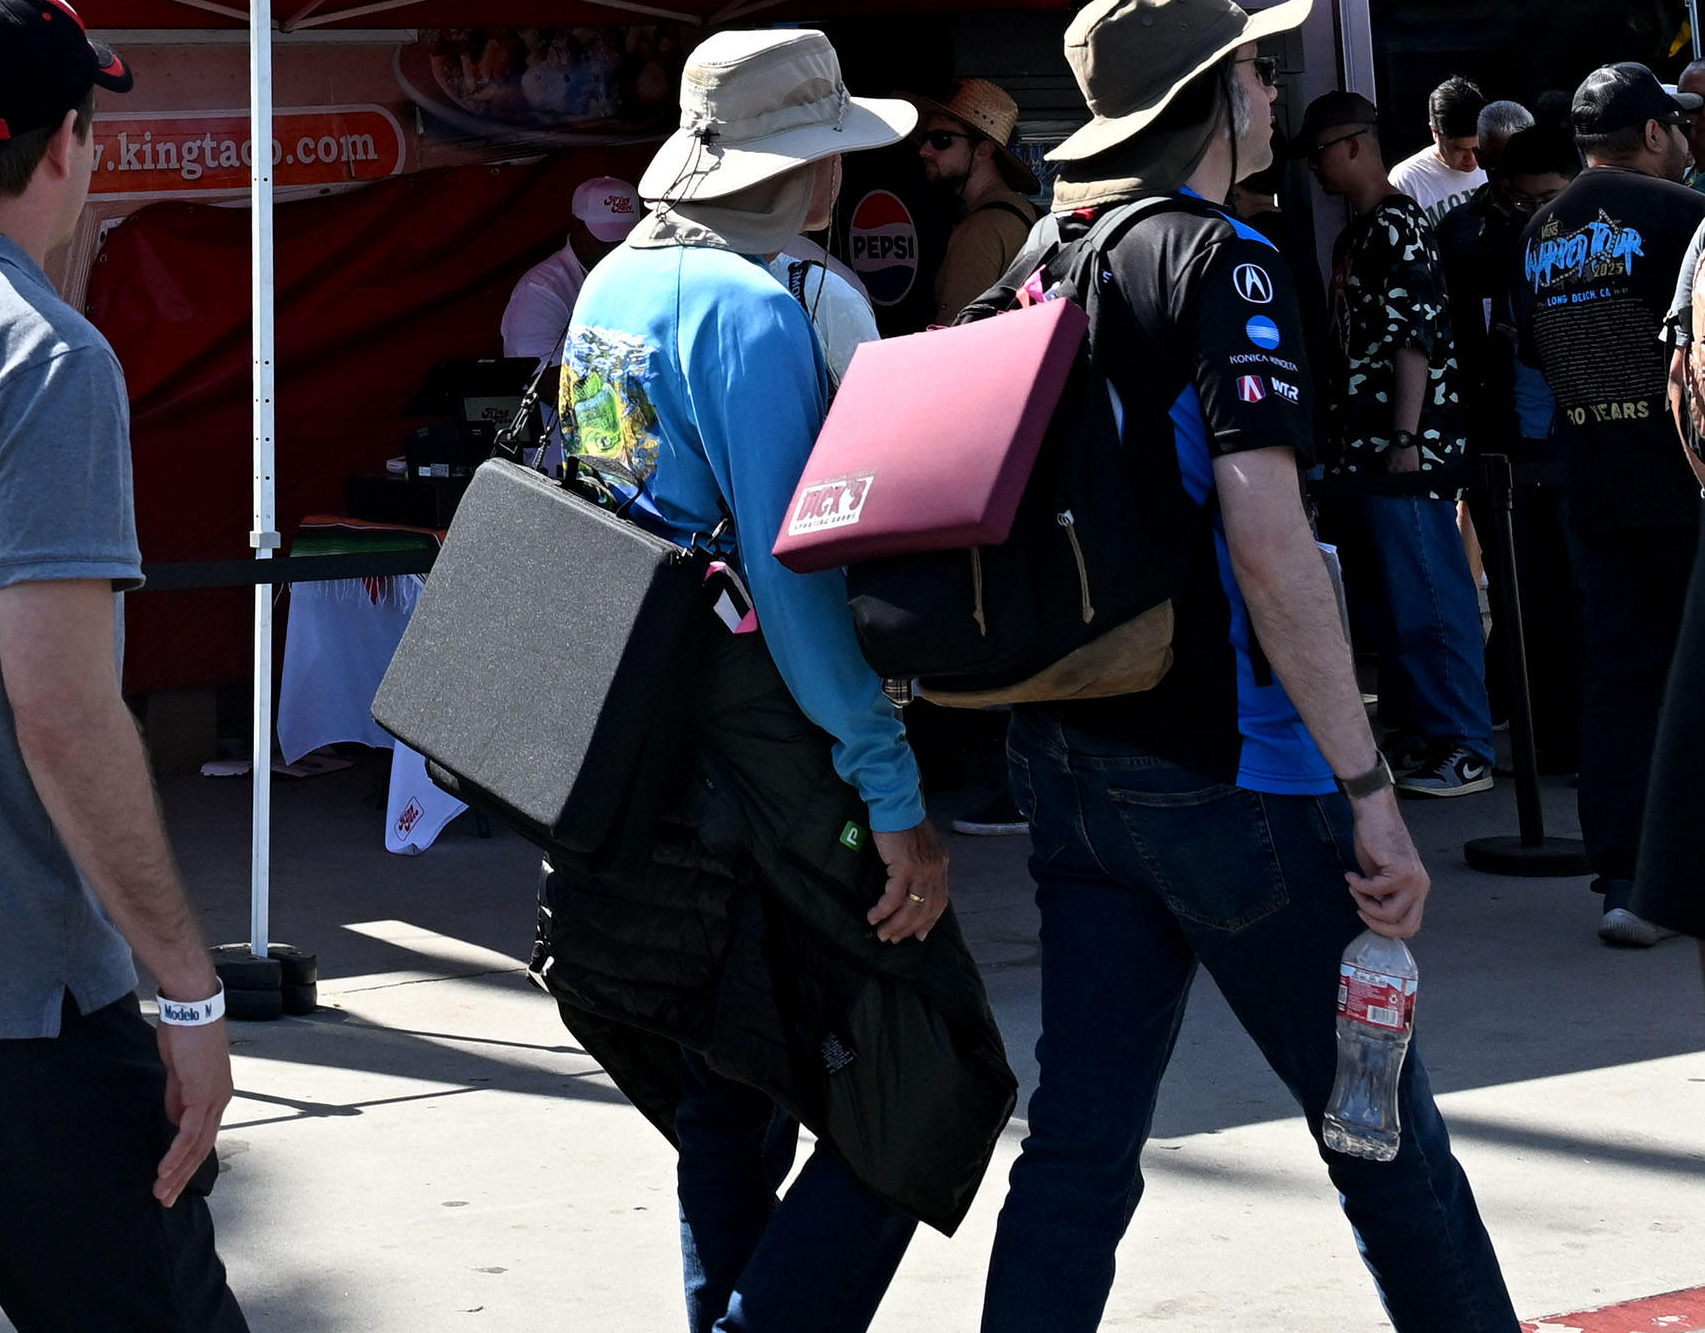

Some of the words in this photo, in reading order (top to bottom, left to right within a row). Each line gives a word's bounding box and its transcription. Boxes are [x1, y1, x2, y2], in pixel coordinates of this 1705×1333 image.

[852, 235, 915, 260] PEPSI
[1594, 262, 1624, 277] 2025
[1547, 295, 1569, 307] LONG
[1600, 287, 1612, 298] CA
[1229, 353, 1269, 365] KONICA
[1270, 376, 1300, 402] WTR
[1592, 401, 1650, 422] YEARS
[164, 1003, 200, 1021] Modelo
